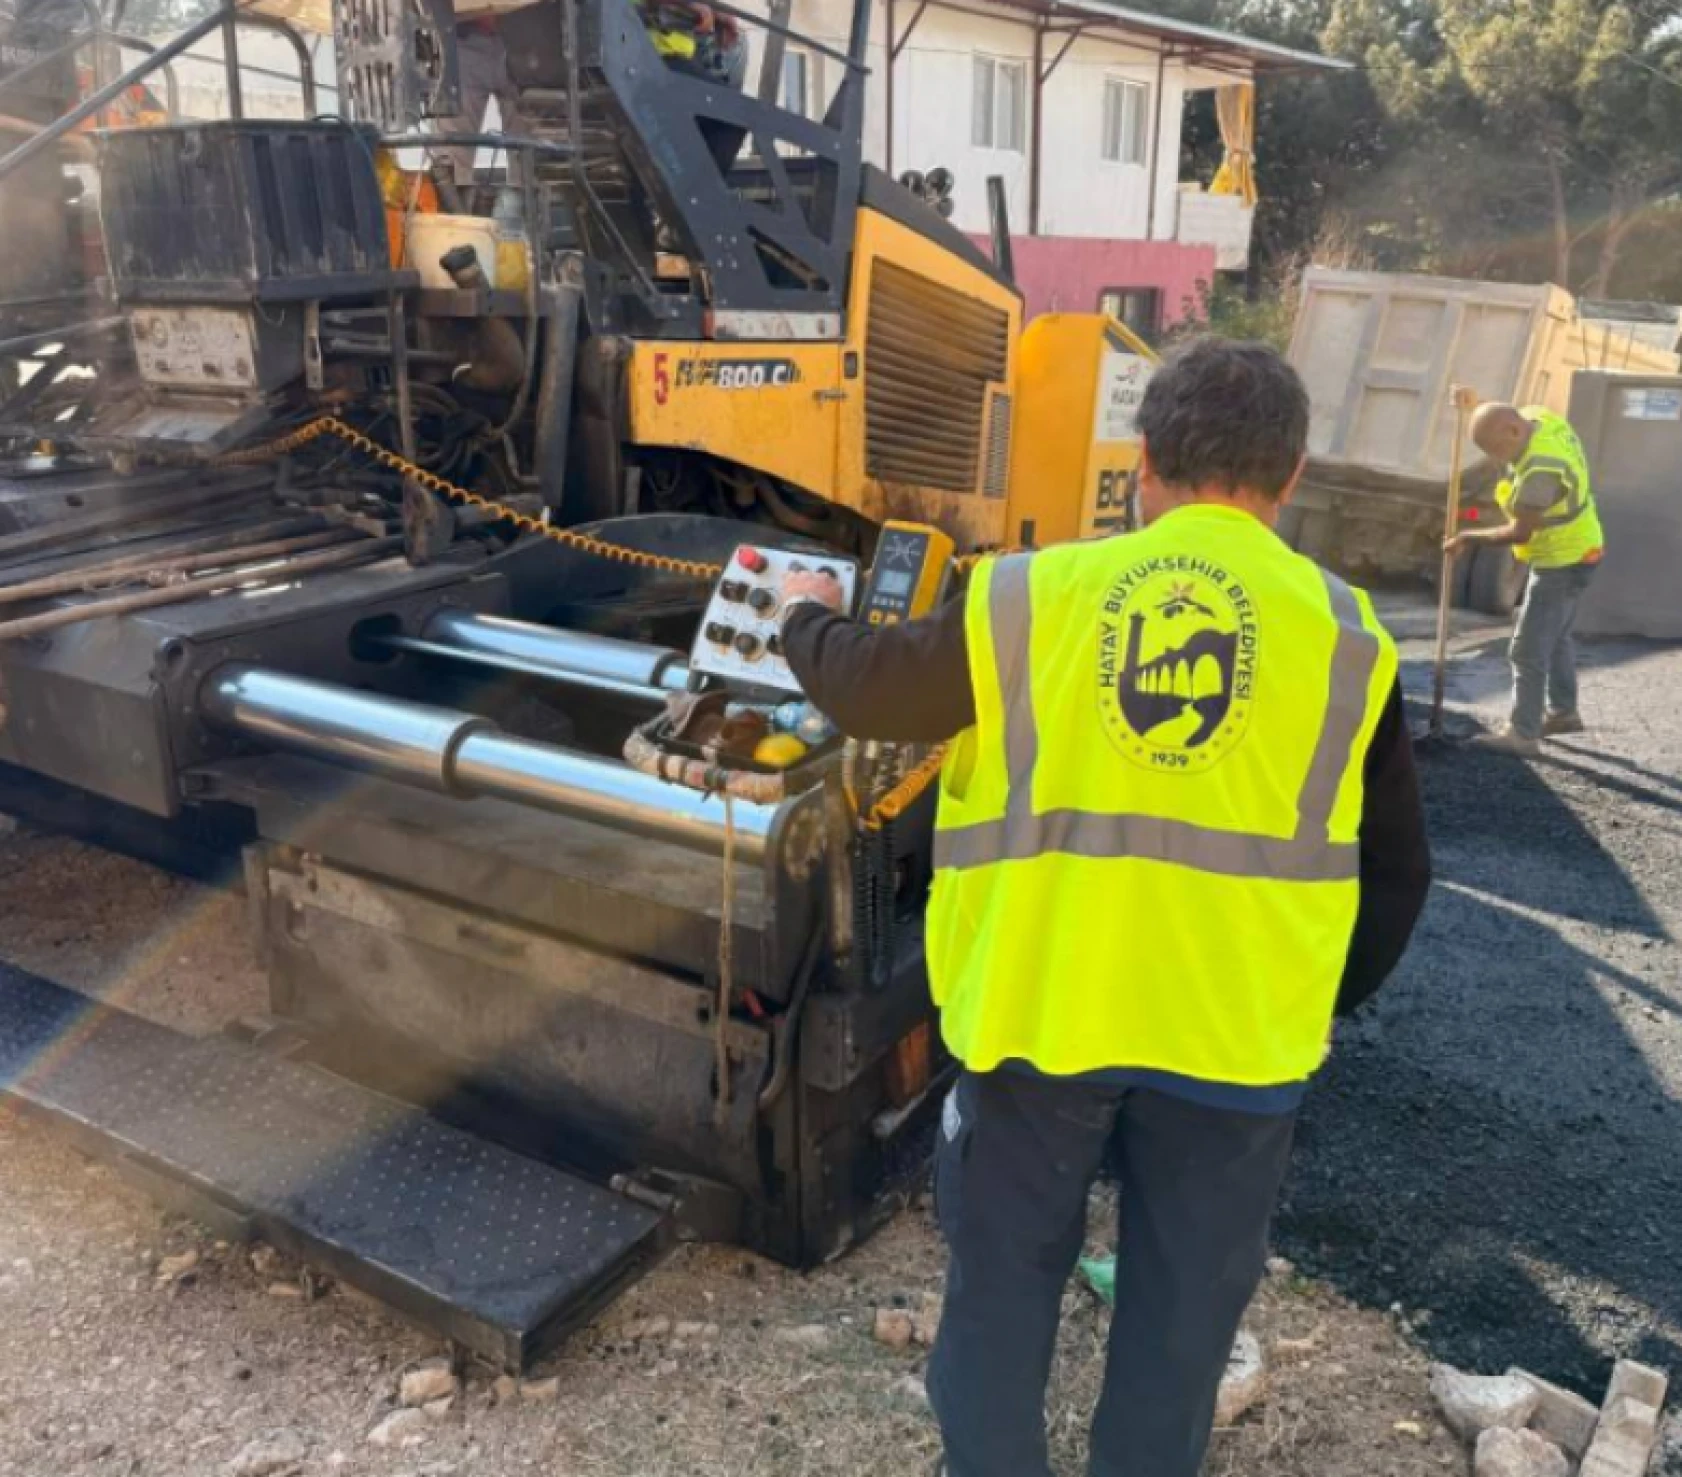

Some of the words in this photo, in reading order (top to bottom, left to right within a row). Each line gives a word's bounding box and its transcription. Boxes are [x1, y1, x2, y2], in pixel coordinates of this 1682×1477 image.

[654, 352, 669, 405] 5
[719, 364, 766, 389] 800
[1100, 621, 1118, 687] HATAY
[1150, 751, 1189, 768] 1939
